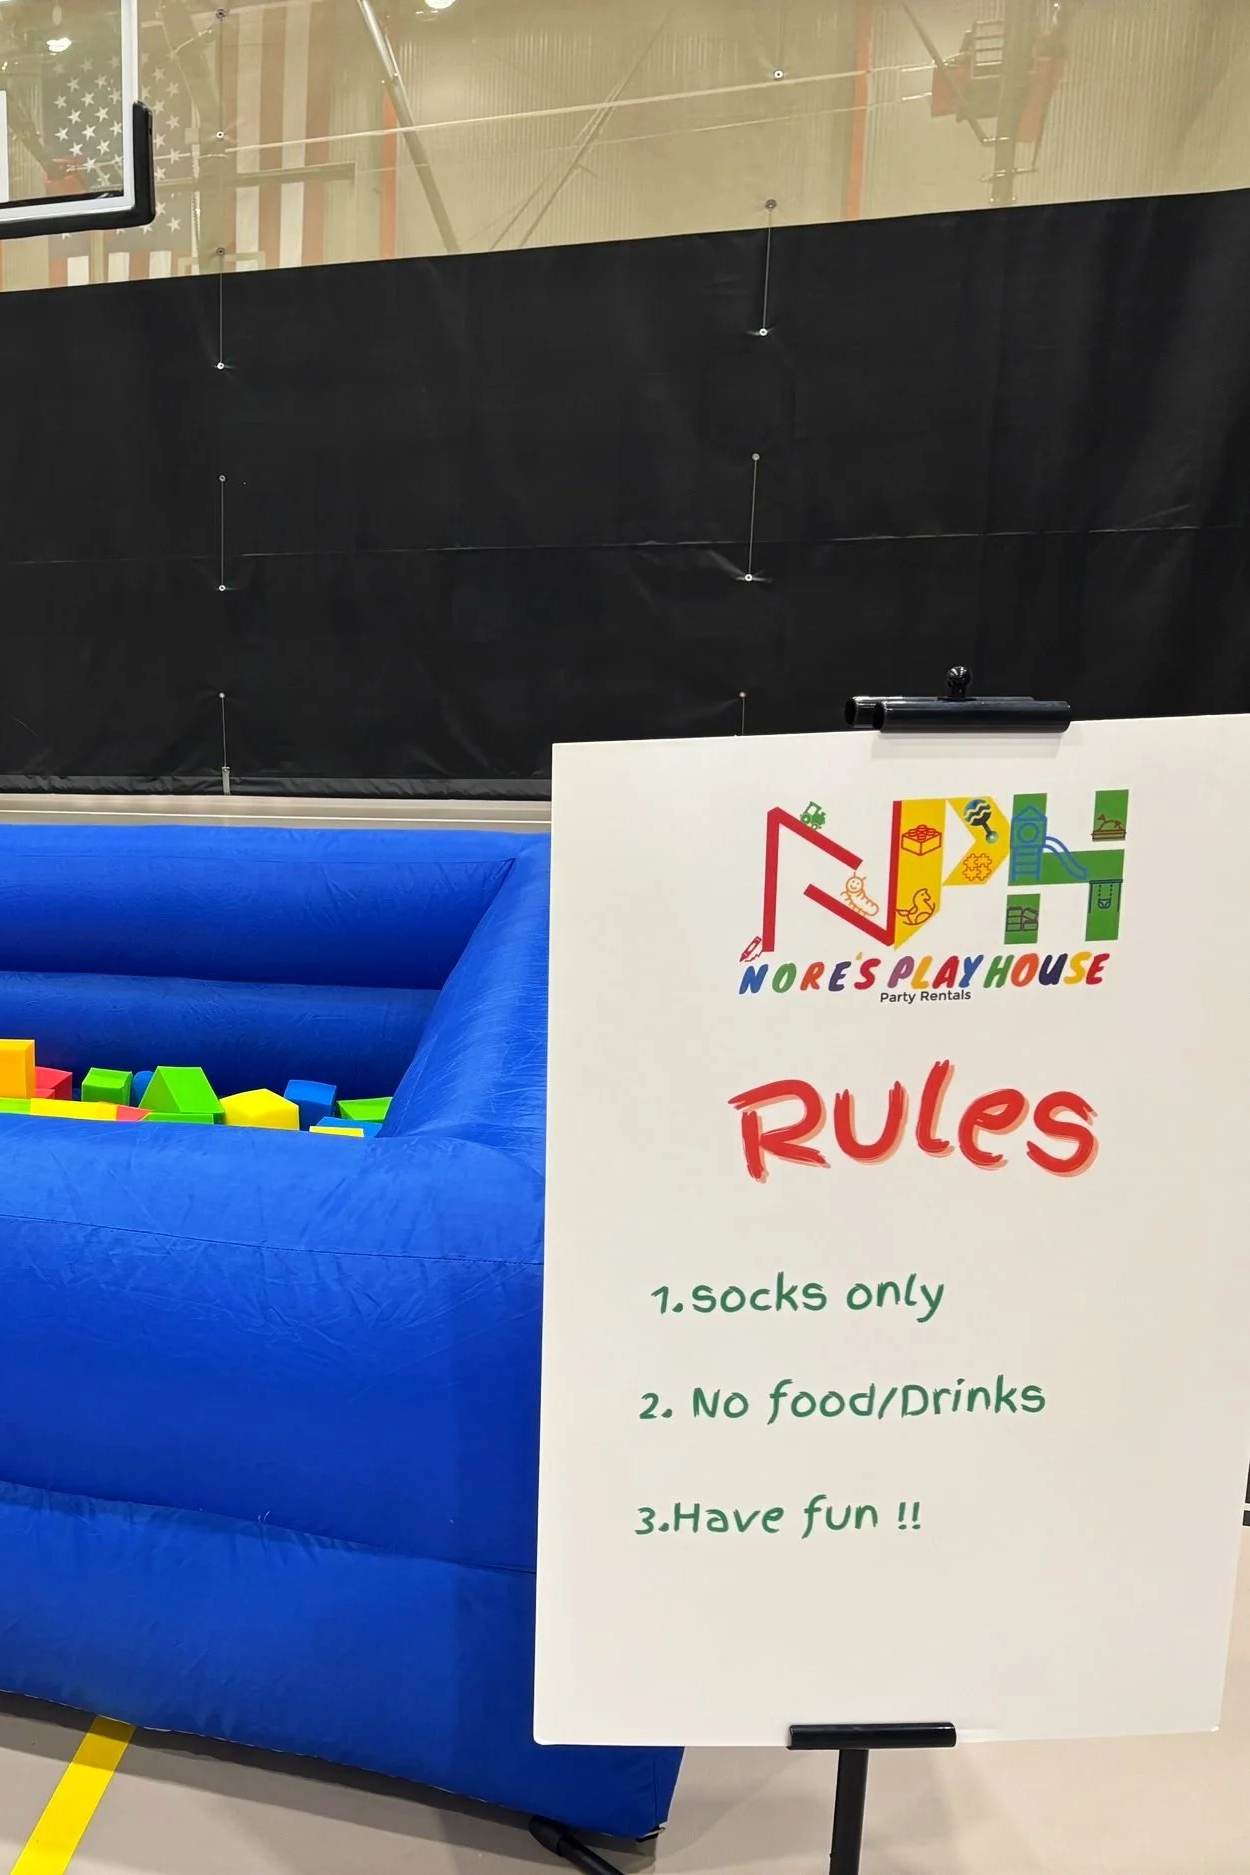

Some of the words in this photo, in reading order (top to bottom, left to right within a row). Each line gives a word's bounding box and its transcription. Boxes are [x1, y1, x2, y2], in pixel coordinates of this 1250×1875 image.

[738, 951, 881, 995] NORE'S
[880, 992, 917, 1005] Party
[919, 988, 972, 1002] Rentals
[728, 1059, 1099, 1183] Rules
[846, 1273, 944, 1323] only
[639, 1393, 673, 1420] 2.
[692, 1387, 749, 1419] No
[767, 1374, 1046, 1425] food/Drinks
[801, 1494, 878, 1539] fun
